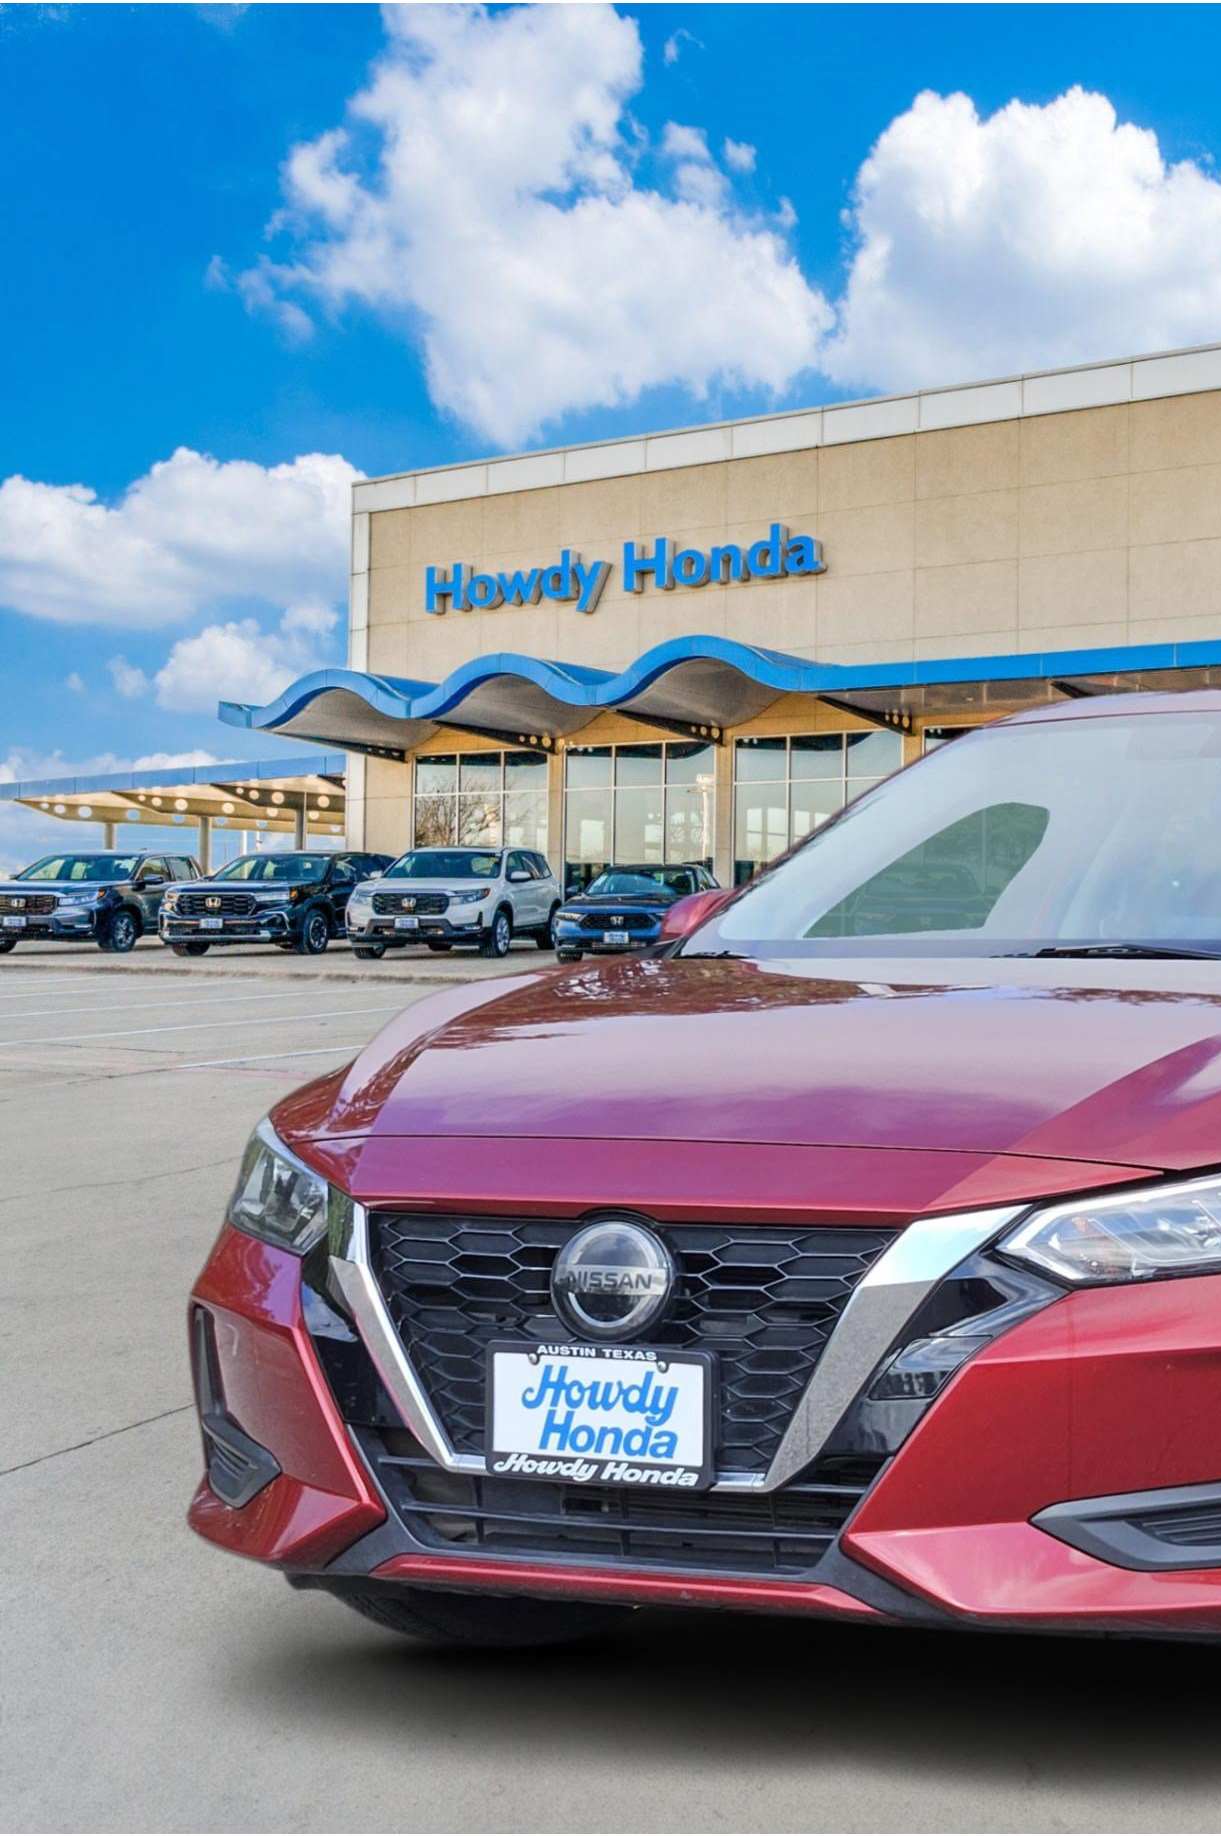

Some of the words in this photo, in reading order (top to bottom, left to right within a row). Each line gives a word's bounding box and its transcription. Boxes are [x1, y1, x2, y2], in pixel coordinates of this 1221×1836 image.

[424, 547, 612, 614] Howdy
[622, 522, 827, 594] Honda
[567, 1270, 653, 1290] NISSAN
[537, 1345, 596, 1357] AUSTIN
[602, 1348, 657, 1361] TEXAS
[521, 1364, 679, 1427] Howdy
[538, 1408, 679, 1459] Honda
[493, 1453, 599, 1482] Howdy
[601, 1461, 699, 1487] Honda
